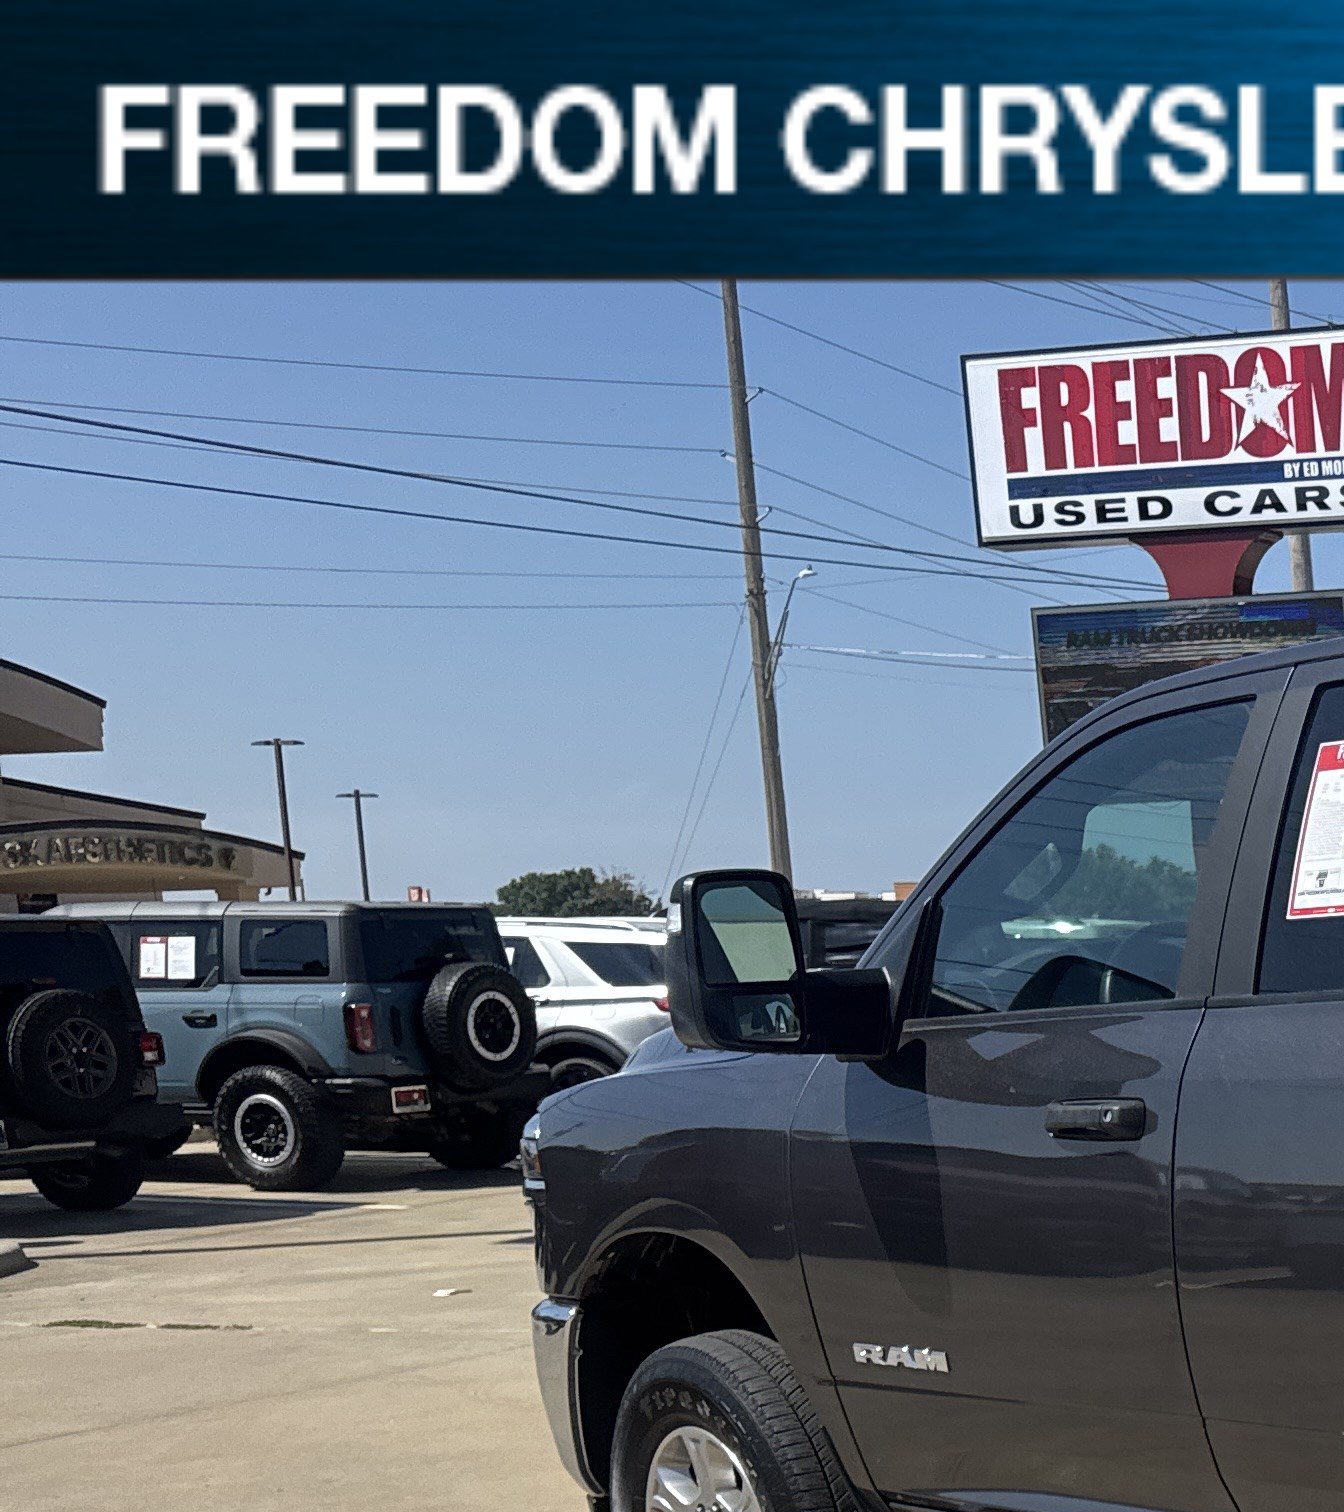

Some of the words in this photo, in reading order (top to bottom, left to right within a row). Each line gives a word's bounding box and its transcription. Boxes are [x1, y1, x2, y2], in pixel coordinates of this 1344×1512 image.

[1283, 460, 1301, 480] BY
[1303, 459, 1320, 478] ED
[1008, 495, 1173, 530] USED
[853, 1342, 950, 1374] RAM
